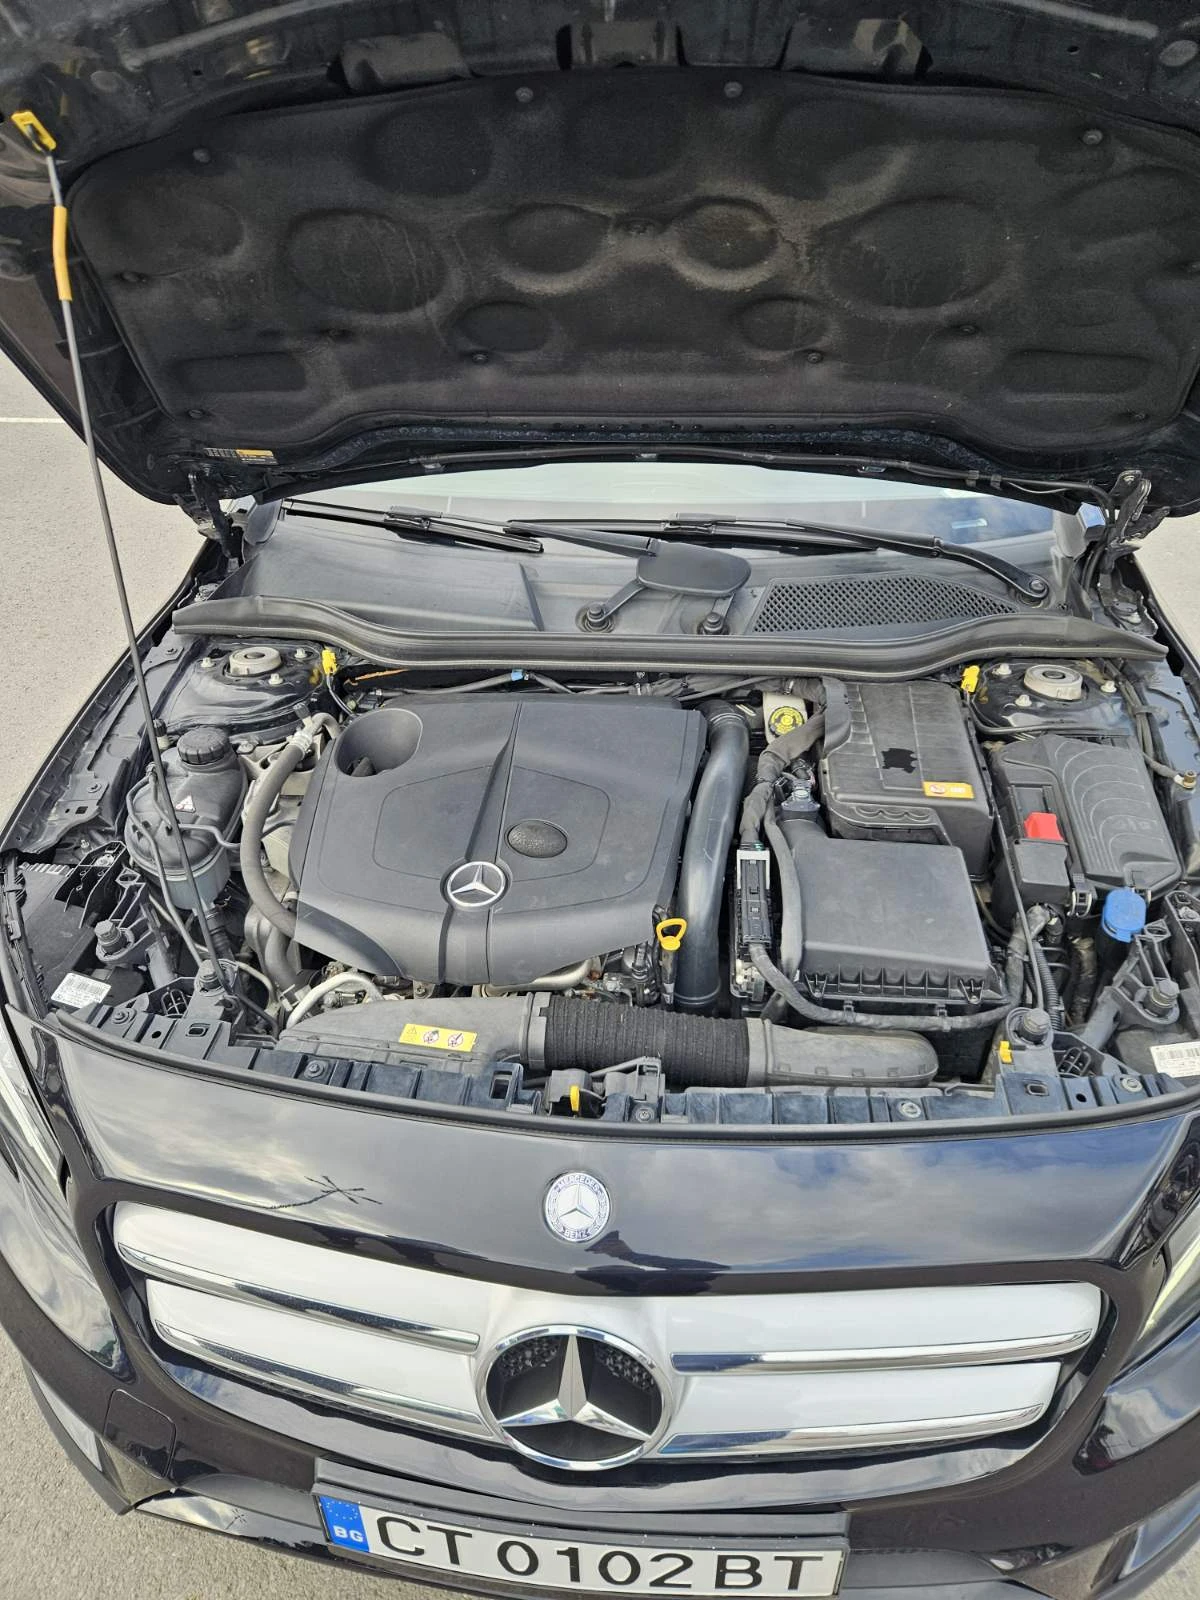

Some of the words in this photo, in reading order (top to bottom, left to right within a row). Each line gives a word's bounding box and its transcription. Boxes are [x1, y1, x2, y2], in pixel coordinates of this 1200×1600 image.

[333, 1525, 364, 1543] BG
[376, 1516, 473, 1566] CT
[497, 1540, 693, 1589] 0102
[715, 1554, 823, 1591] BT
